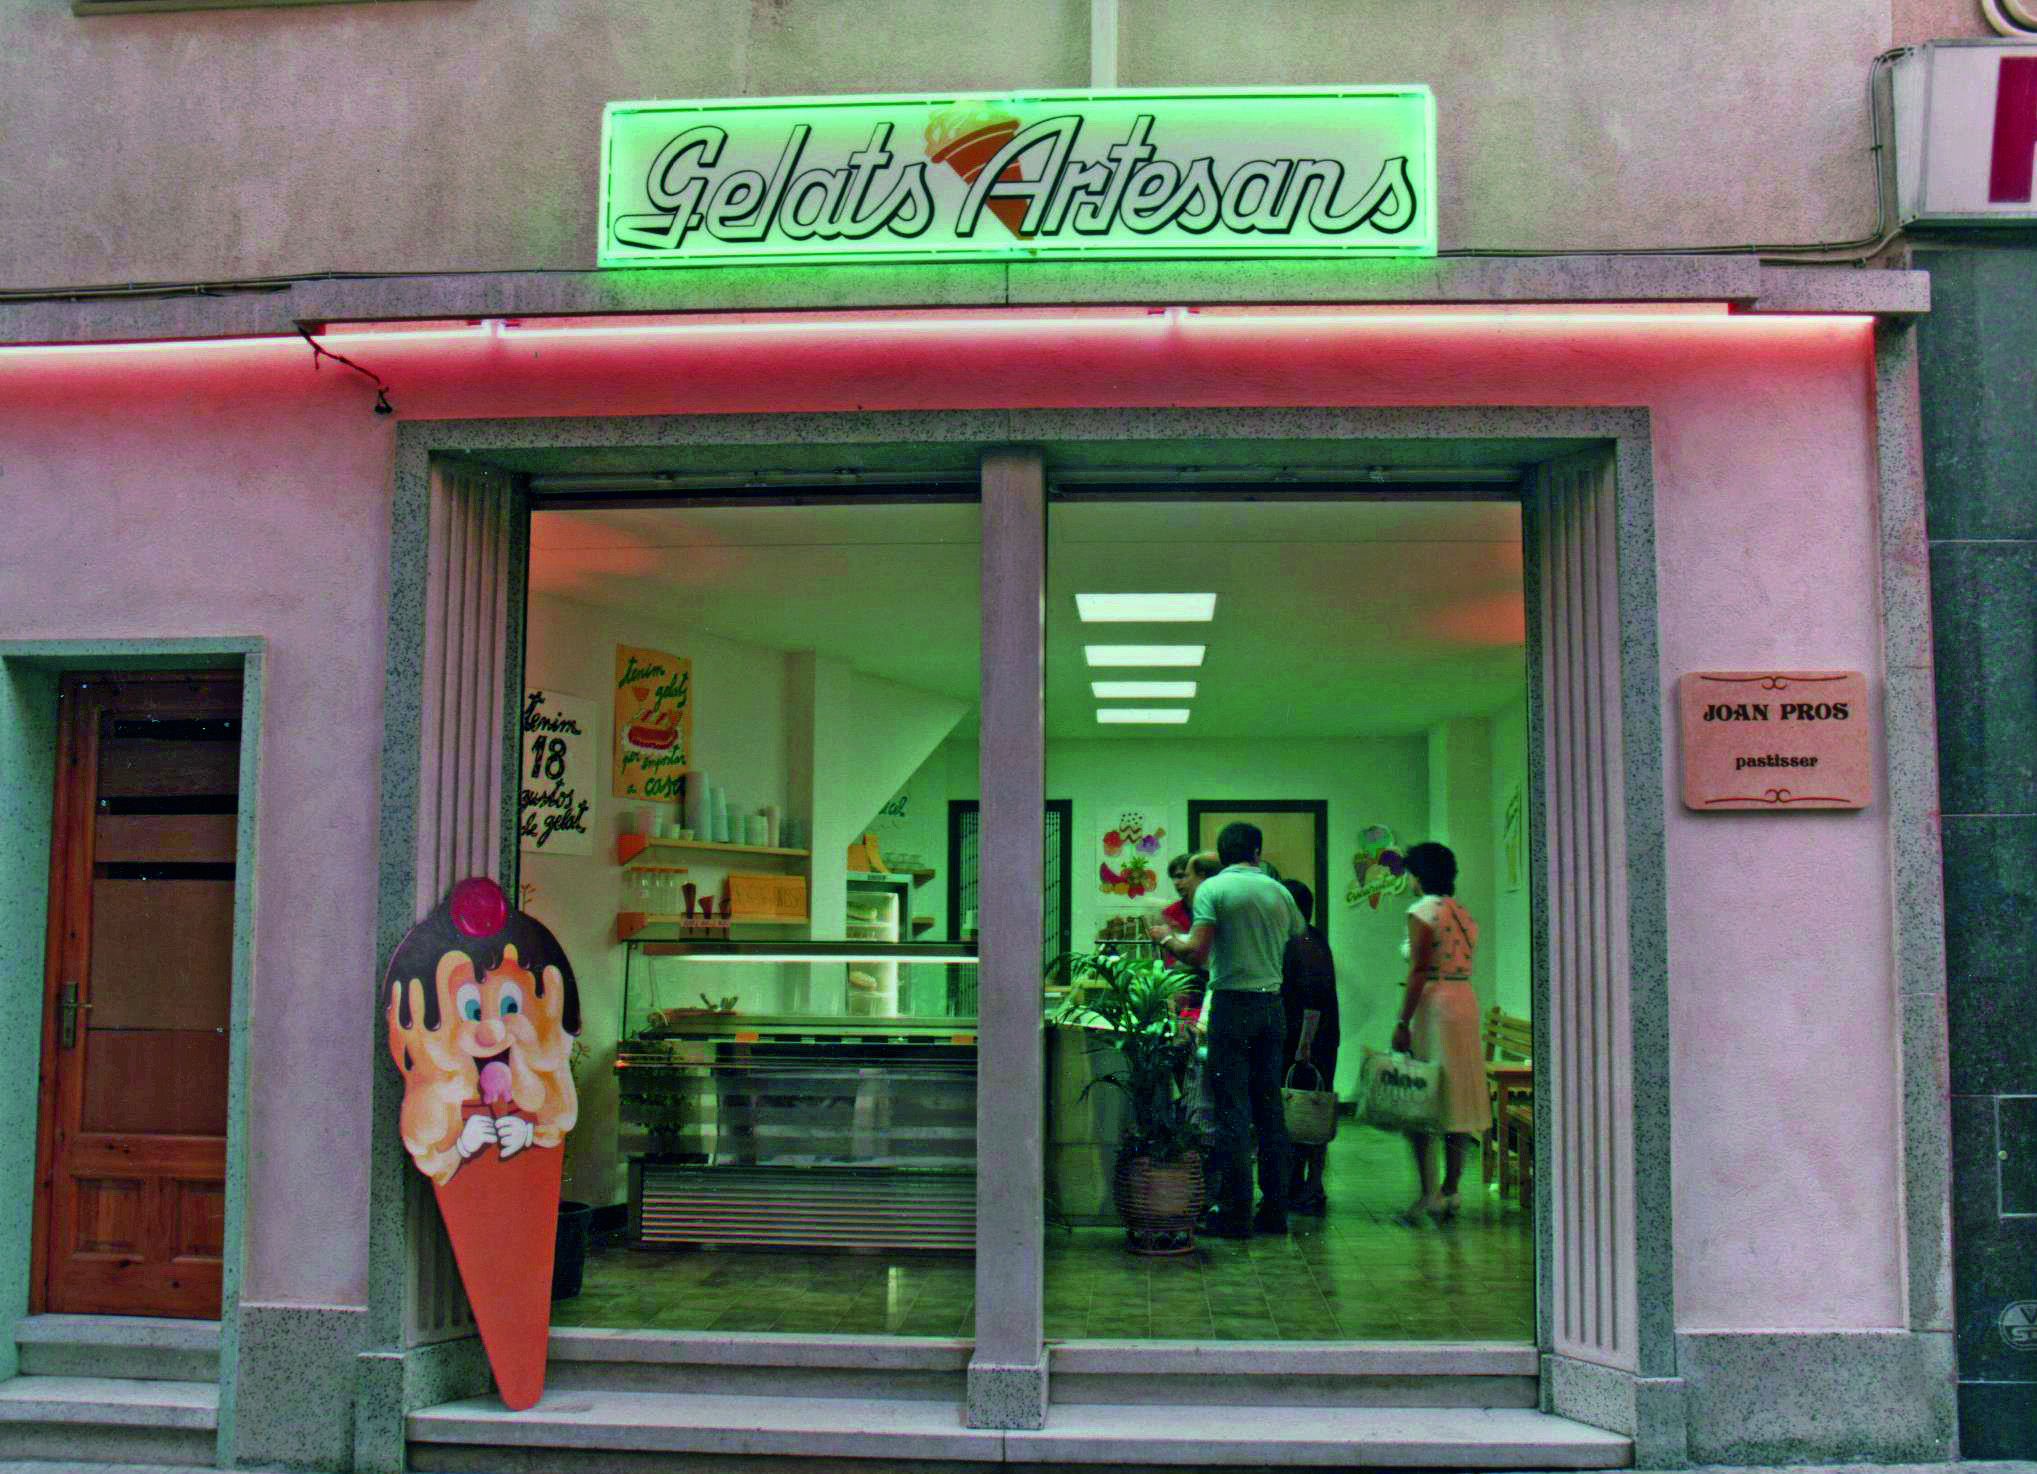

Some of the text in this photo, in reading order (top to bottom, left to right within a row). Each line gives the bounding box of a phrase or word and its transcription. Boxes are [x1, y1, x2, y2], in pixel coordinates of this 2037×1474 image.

[613, 114, 1417, 249] Gelats Artesans
[1703, 702, 1849, 721] JOAN PROS
[531, 735, 567, 780] 18
[1735, 753, 1819, 770] pastisser
[537, 799, 589, 848] gelat
